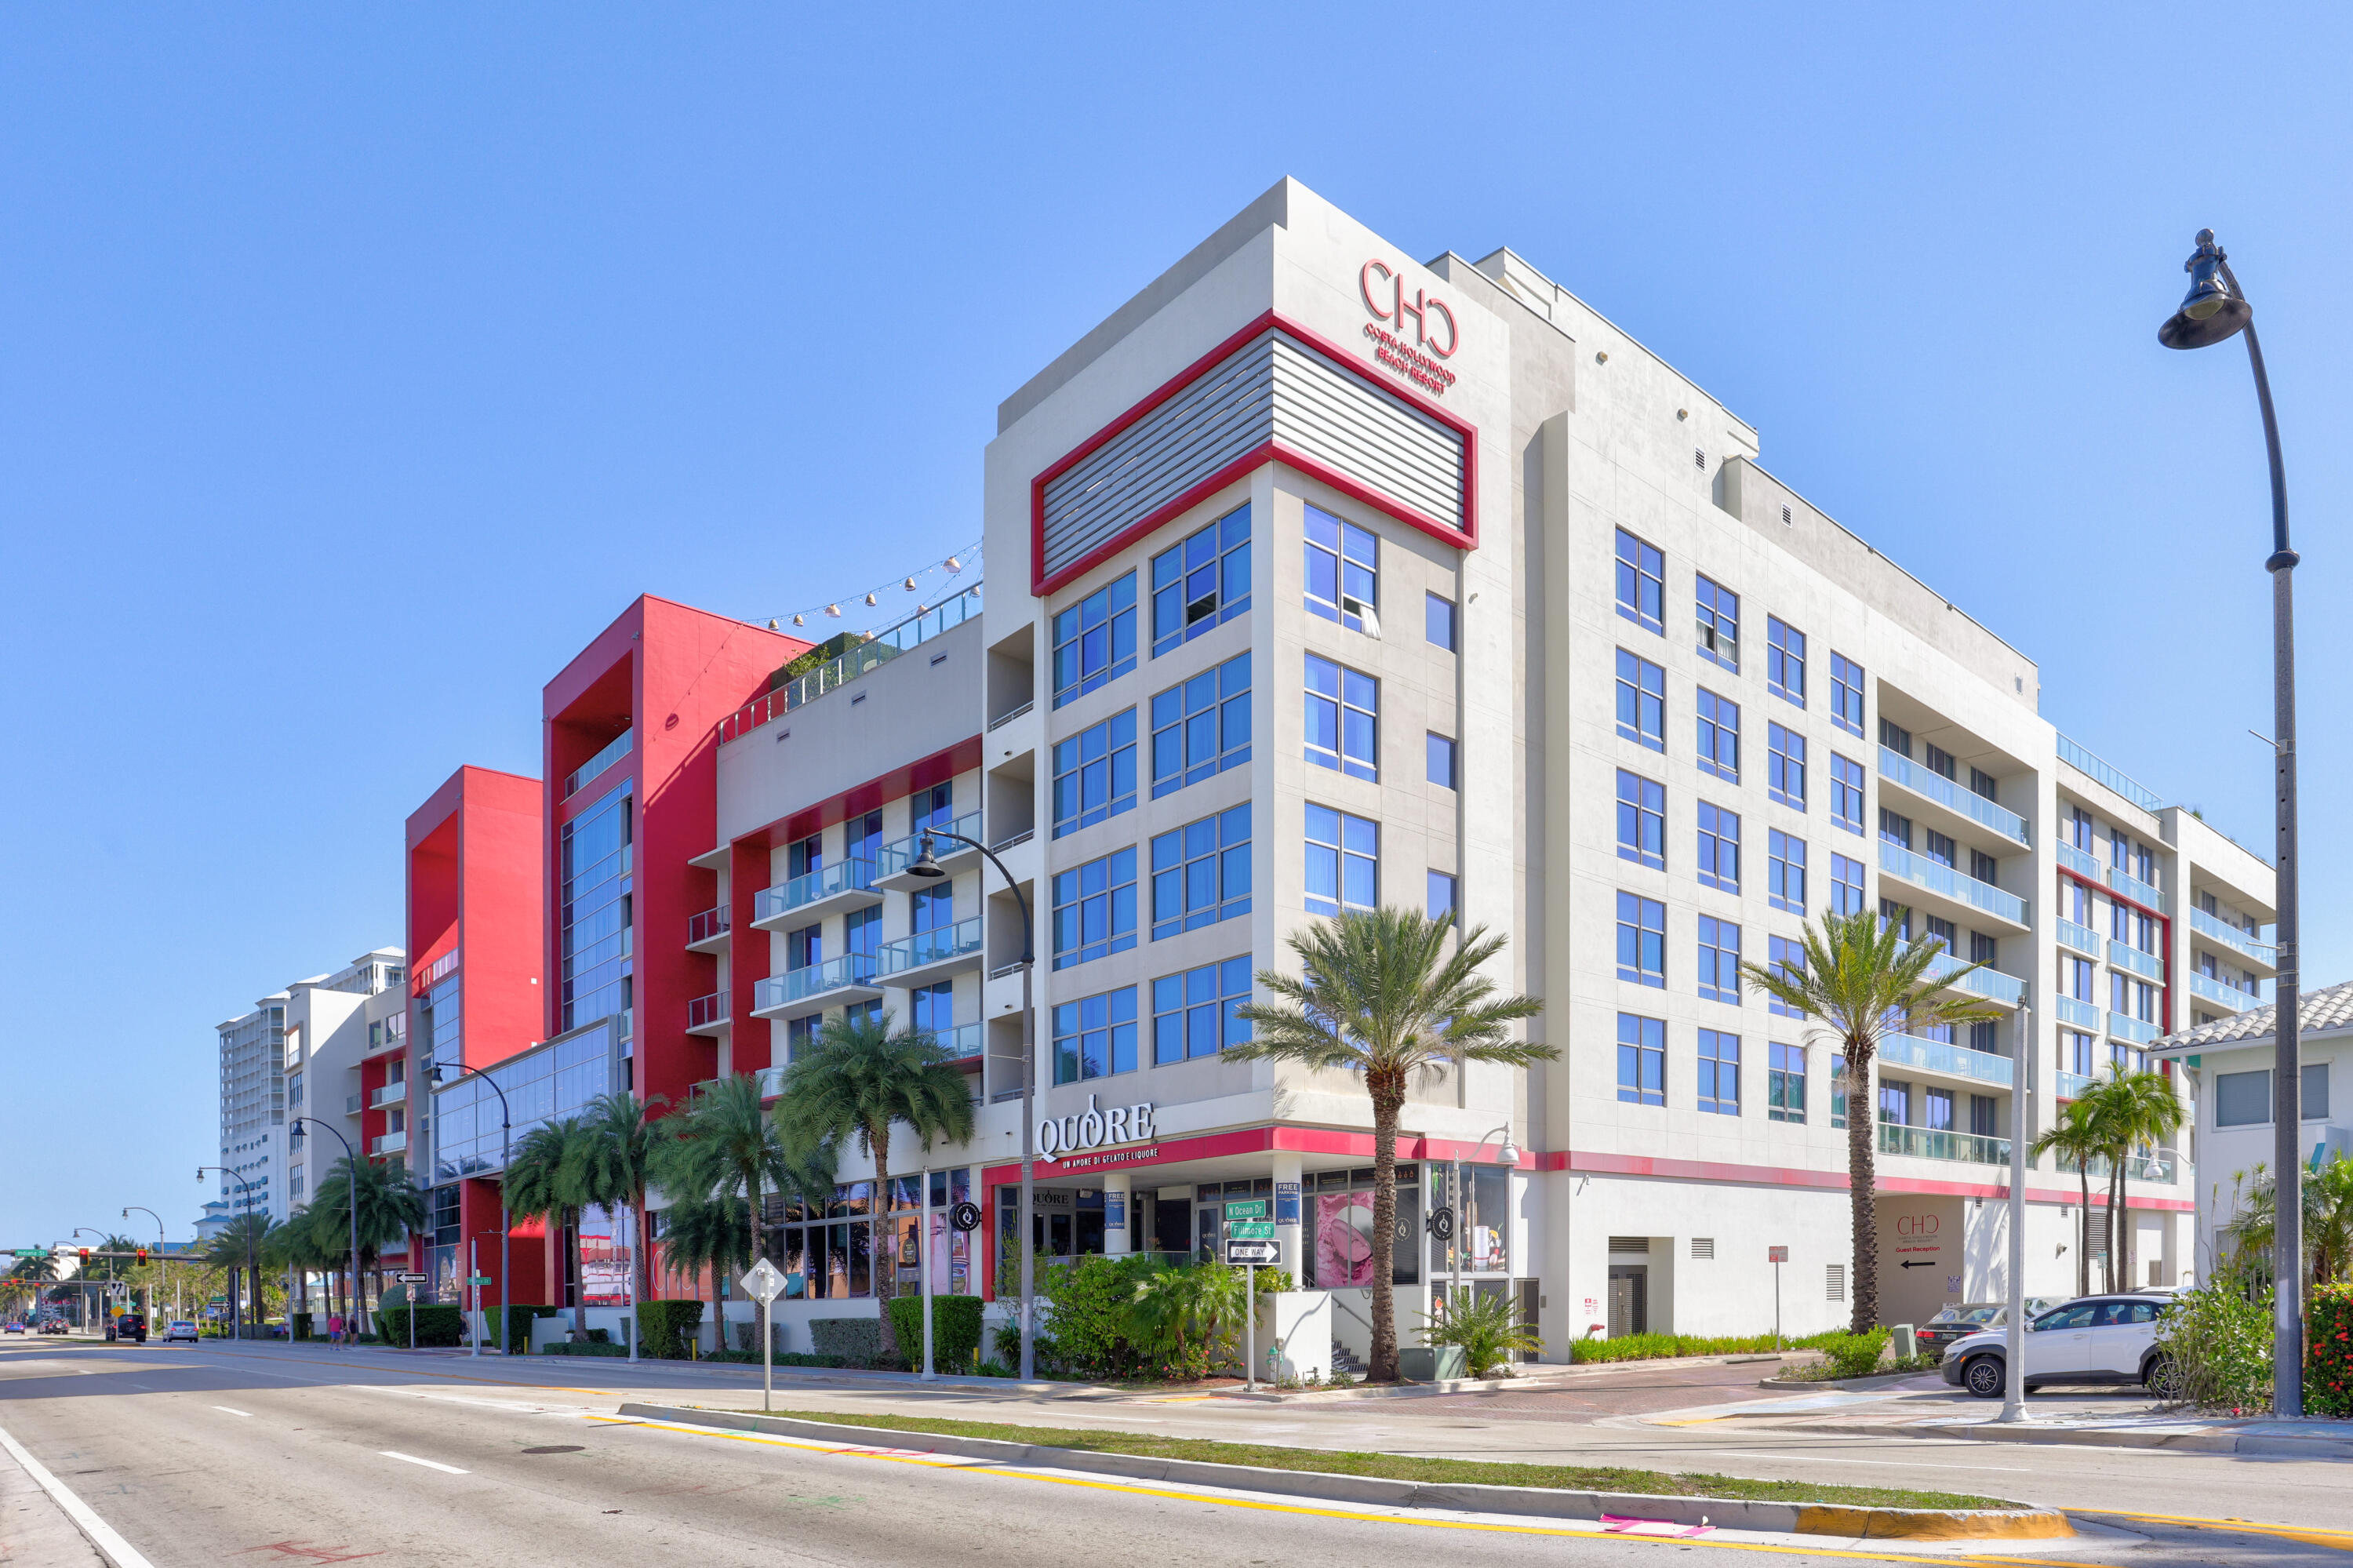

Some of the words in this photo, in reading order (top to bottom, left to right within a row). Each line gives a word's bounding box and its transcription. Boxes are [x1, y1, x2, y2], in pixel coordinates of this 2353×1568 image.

[1366, 322, 1398, 349] COSTA
[1400, 341, 1457, 384] HOLLYWOOD
[1377, 346, 1409, 373] BEACH
[1411, 366, 1446, 395] RESORT
[1063, 1160, 1071, 1169] UN
[1072, 1157, 1092, 1168] AMORE
[1102, 1152, 1125, 1163] GELATO
[1126, 1151, 1130, 1161] E
[1131, 1148, 1158, 1160] LIQUORE
[1229, 1207, 1234, 1216] N
[1235, 1206, 1253, 1215] Ocean
[1255, 1204, 1263, 1213] Dr
[1234, 1225, 1262, 1235] Fillmore
[1264, 1225, 1271, 1235] St
